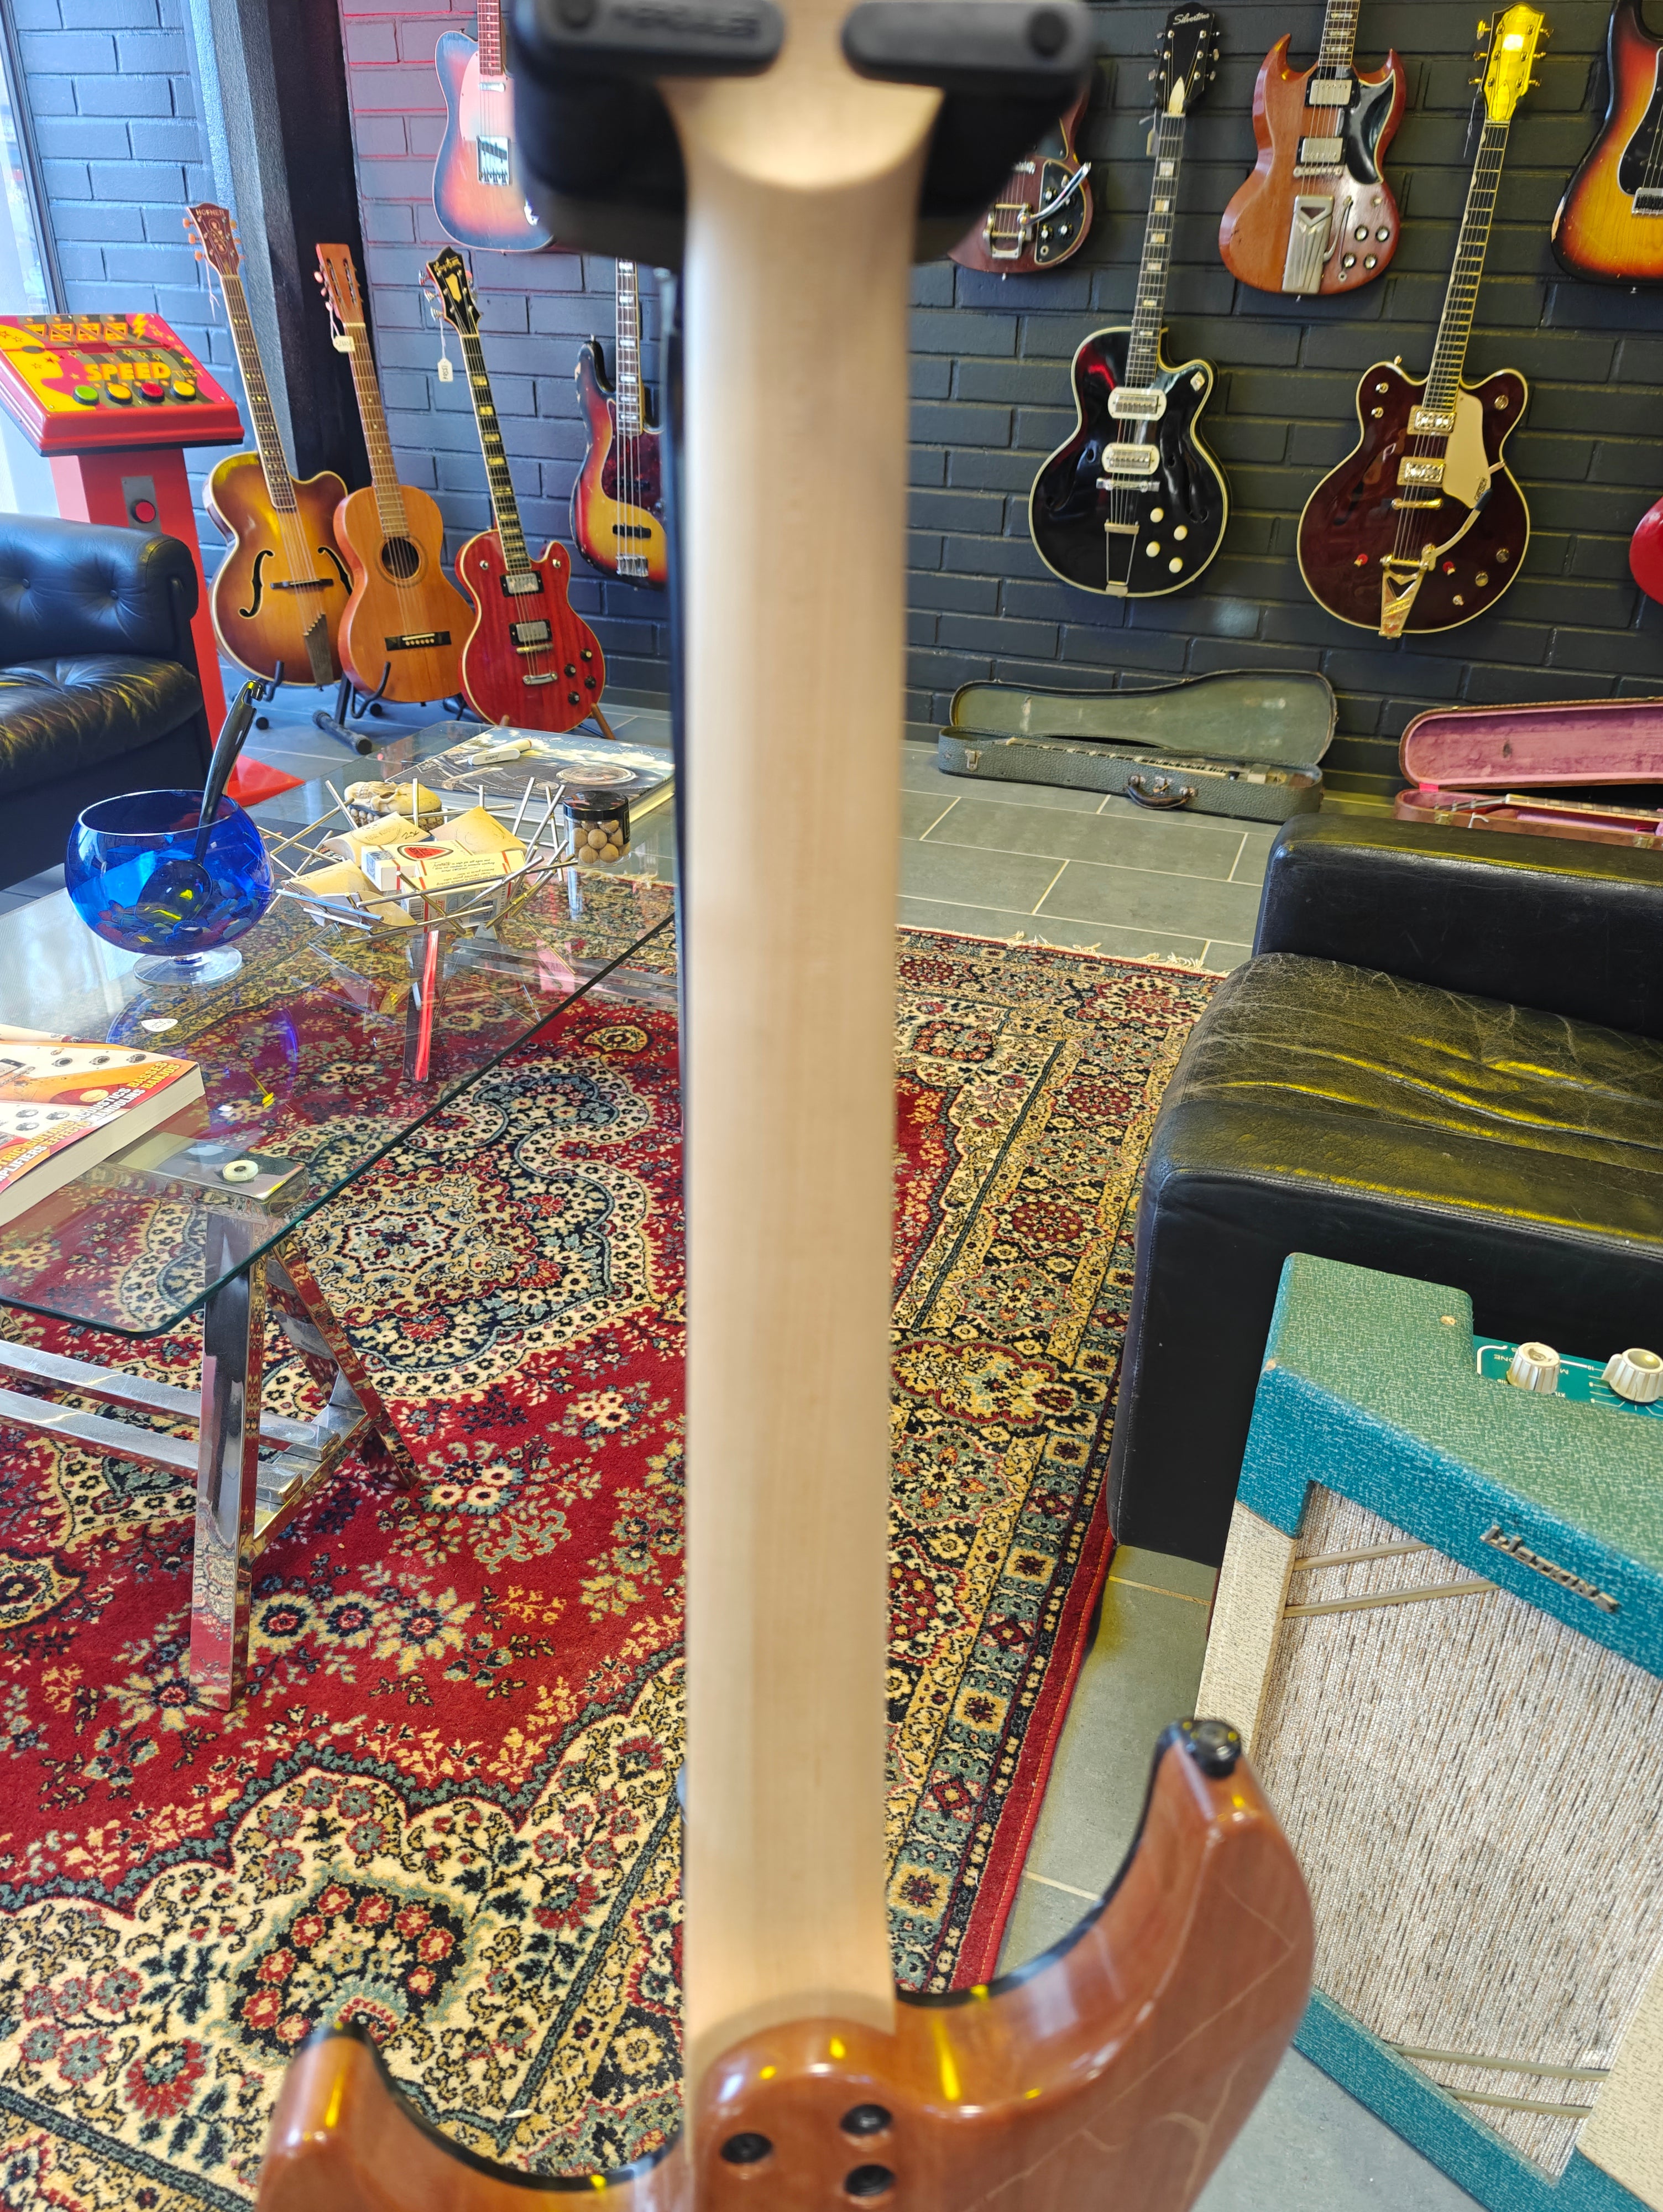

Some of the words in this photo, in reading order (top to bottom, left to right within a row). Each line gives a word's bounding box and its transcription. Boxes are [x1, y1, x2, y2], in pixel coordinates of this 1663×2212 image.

[1173, 12, 1210, 25] Silvertone
[83, 362, 171, 381] SPEED
[171, 369, 203, 378] TEST
[511, 734, 579, 745] PORSCHE
[601, 745, 667, 758] FINLAND
[23, 1120, 76, 1147] GUITARS
[74, 1088, 132, 1121] ACOUSTICS
[126, 1061, 168, 1088] BASSES
[44, 1120, 92, 1145] EFFECTS
[88, 1088, 146, 1121] MANDOLINS
[140, 1063, 180, 1089] BANJOS
